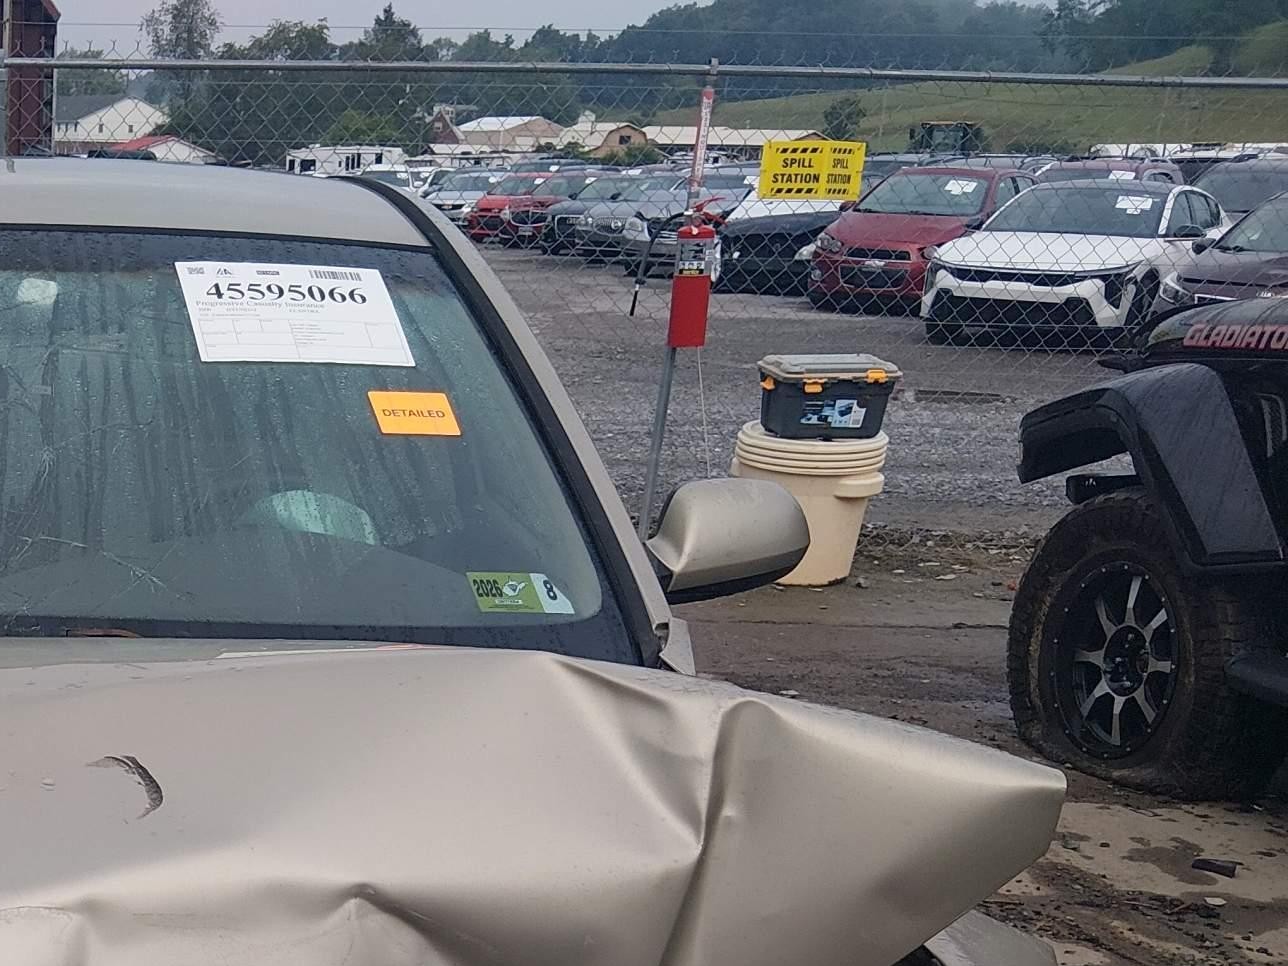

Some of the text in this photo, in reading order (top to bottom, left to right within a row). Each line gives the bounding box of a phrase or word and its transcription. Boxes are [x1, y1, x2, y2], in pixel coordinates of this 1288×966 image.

[782, 158, 814, 169] SPILL
[832, 158, 849, 169] SPILL
[772, 173, 821, 184] STATION
[826, 173, 851, 184] STATION
[206, 282, 368, 304] 45595066
[195, 300, 245, 308] Progressive
[246, 300, 282, 308] Casualty
[1183, 324, 1288, 350] GLADIATO
[382, 409, 446, 418] DETAILED
[473, 579, 503, 597] 2026
[543, 580, 558, 601] 8
